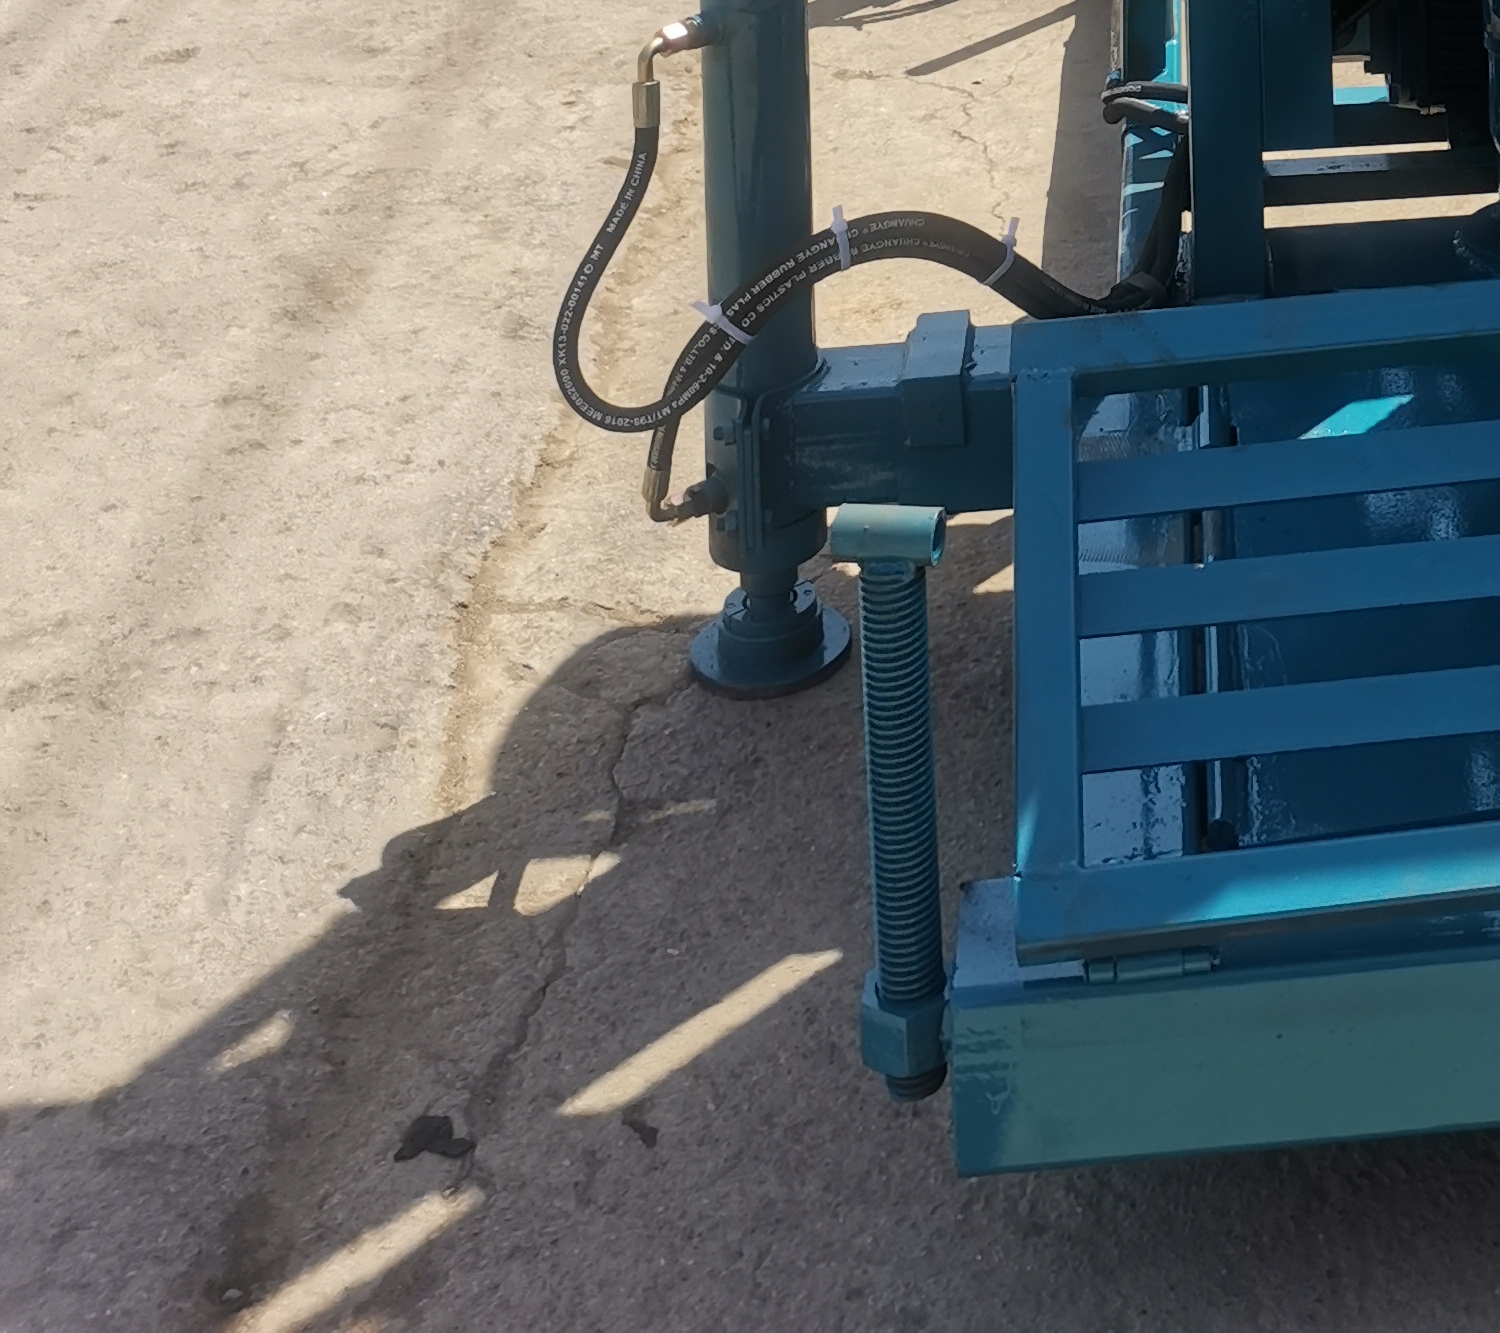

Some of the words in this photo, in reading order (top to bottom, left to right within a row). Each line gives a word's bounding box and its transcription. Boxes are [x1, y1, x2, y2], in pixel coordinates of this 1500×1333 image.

[629, 151, 648, 187] CHINA
[625, 187, 636, 202] IN
[605, 201, 630, 234] MADE
[591, 243, 604, 261] MT
[795, 227, 860, 264] CANGYE
[808, 245, 860, 274] RBBER
[859, 237, 922, 255] CHUANGYE
[752, 257, 796, 294] RUBBER
[755, 269, 808, 313] PLASTICS
[711, 293, 753, 336] PLASCS
